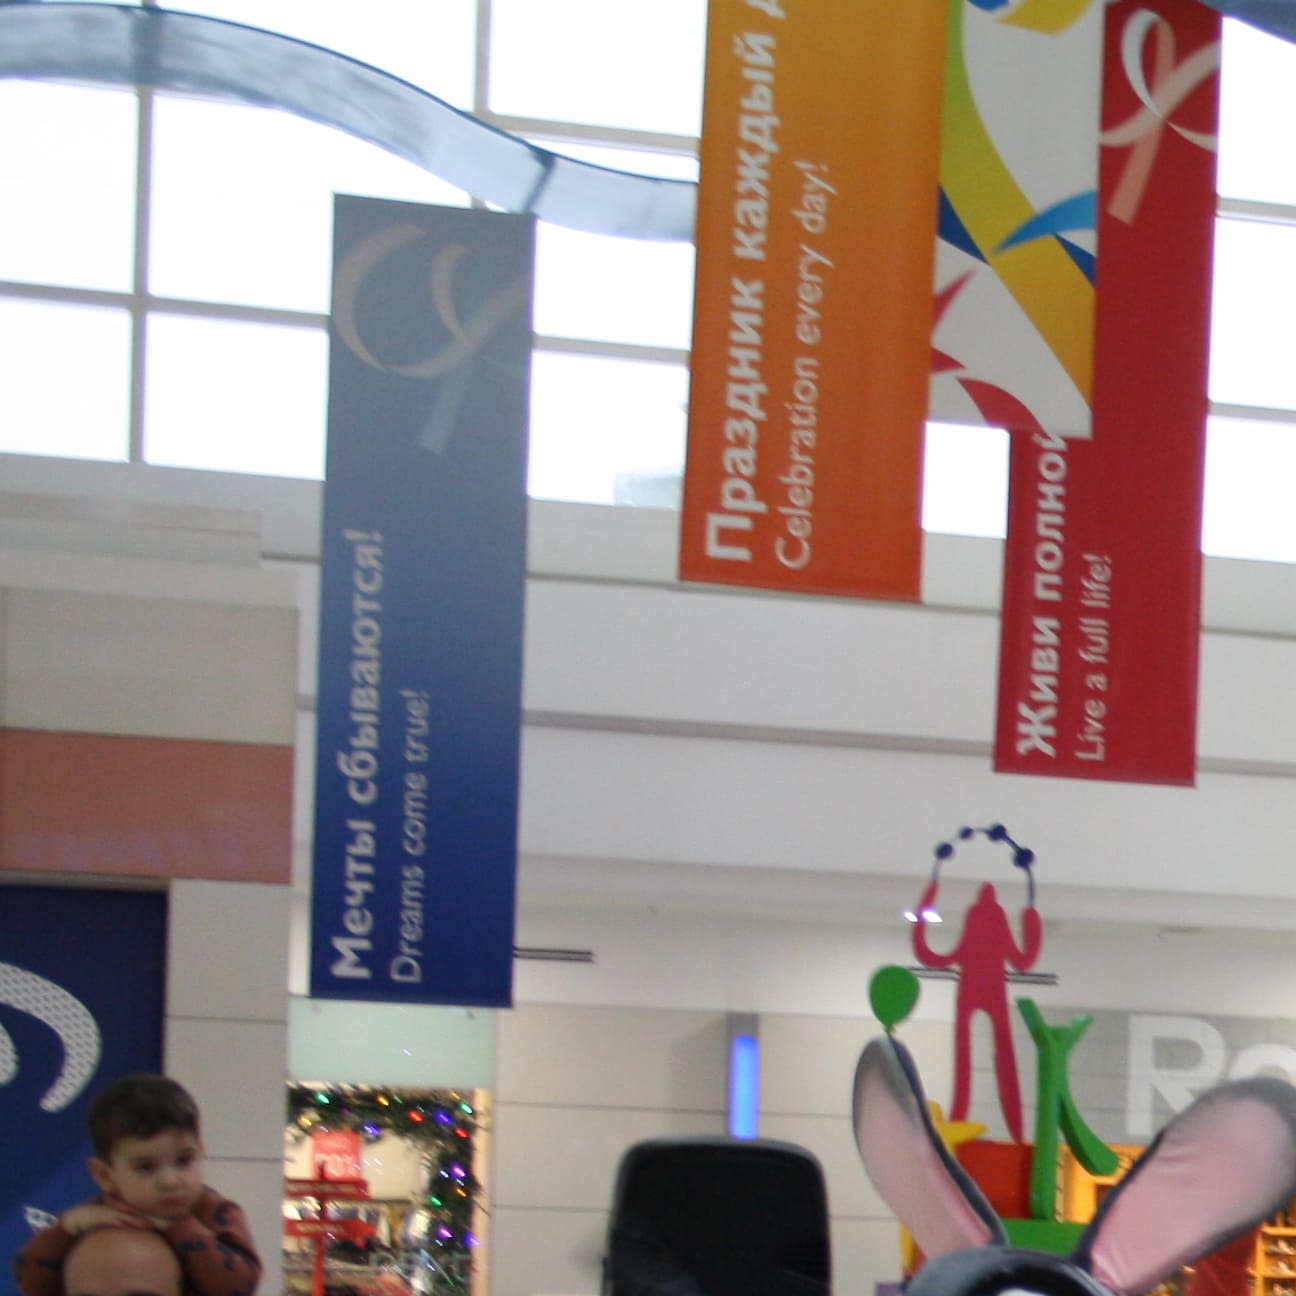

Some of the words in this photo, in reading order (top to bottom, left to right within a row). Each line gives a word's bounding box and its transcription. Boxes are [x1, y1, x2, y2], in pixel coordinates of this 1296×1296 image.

[732, 31, 780, 261] каждый
[792, 160, 838, 235] day!
[796, 243, 834, 346] every
[705, 276, 769, 562] Праздник
[775, 356, 821, 570] Celebration
[1081, 553, 1113, 609] life!
[337, 528, 385, 805] сбываются!
[1015, 615, 1062, 758] Живи
[1078, 617, 1110, 663] full
[1087, 671, 1108, 691] a
[400, 688, 431, 763] true!
[1075, 698, 1107, 762] Live
[402, 771, 429, 857] come
[330, 819, 377, 980] Мечты
[390, 865, 426, 985] Dreams
